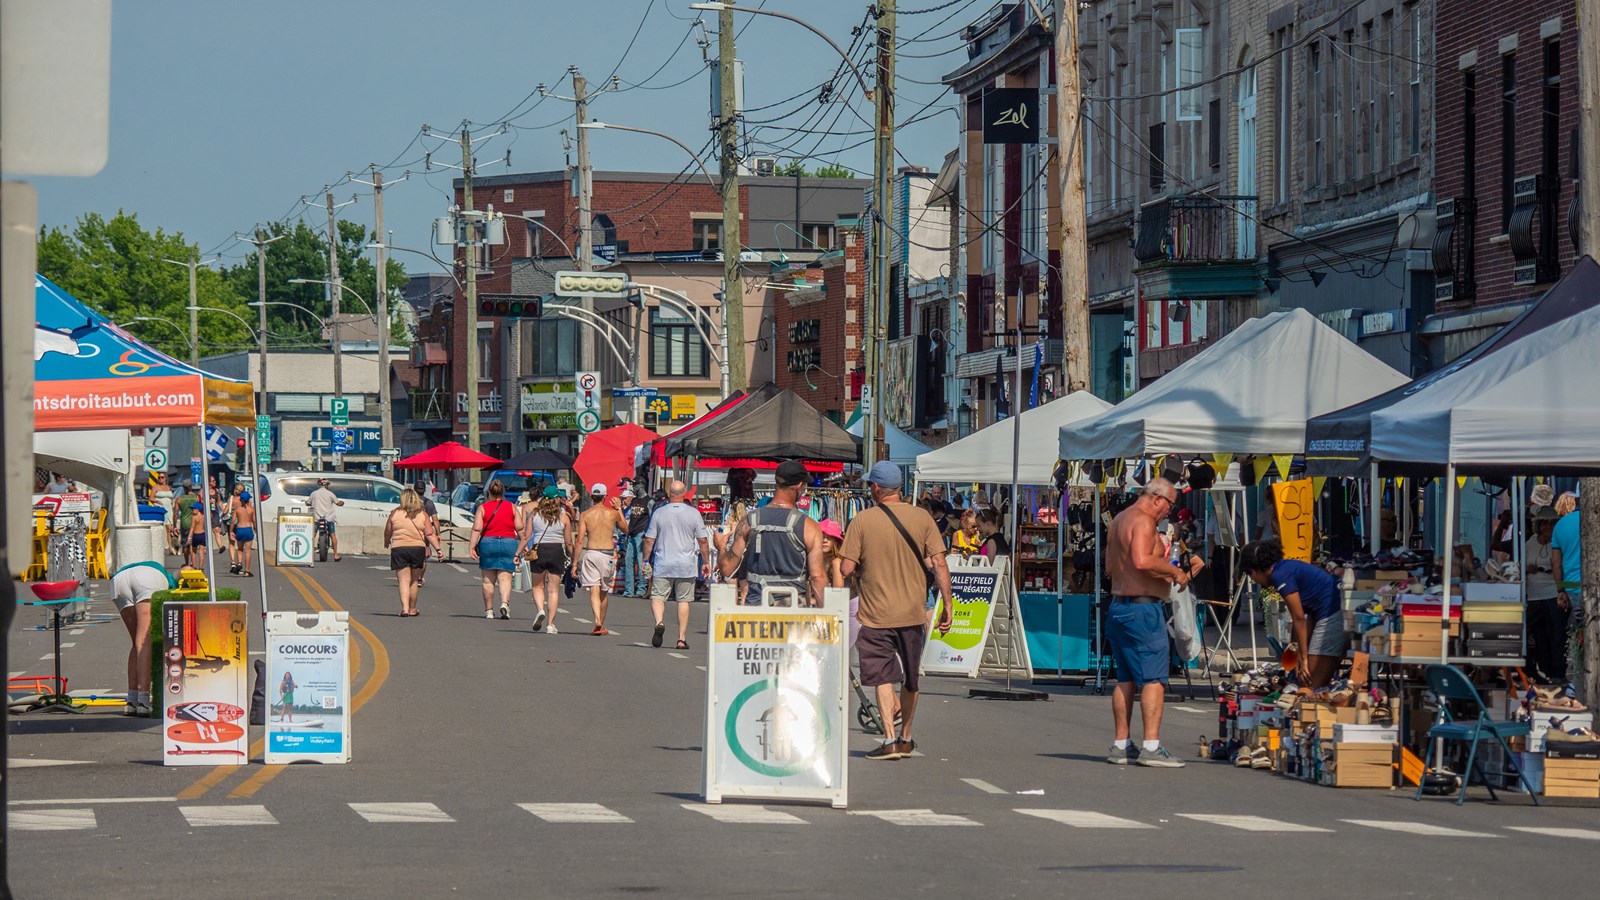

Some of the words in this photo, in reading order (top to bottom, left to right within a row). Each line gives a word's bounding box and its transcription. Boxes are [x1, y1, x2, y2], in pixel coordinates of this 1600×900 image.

[334, 401, 345, 414] P
[258, 421, 269, 429] 132
[363, 432, 381, 440] RBC
[962, 585, 992, 594] RÉGATES
[279, 645, 338, 654] CONCOURS
[743, 663, 760, 675] EN
